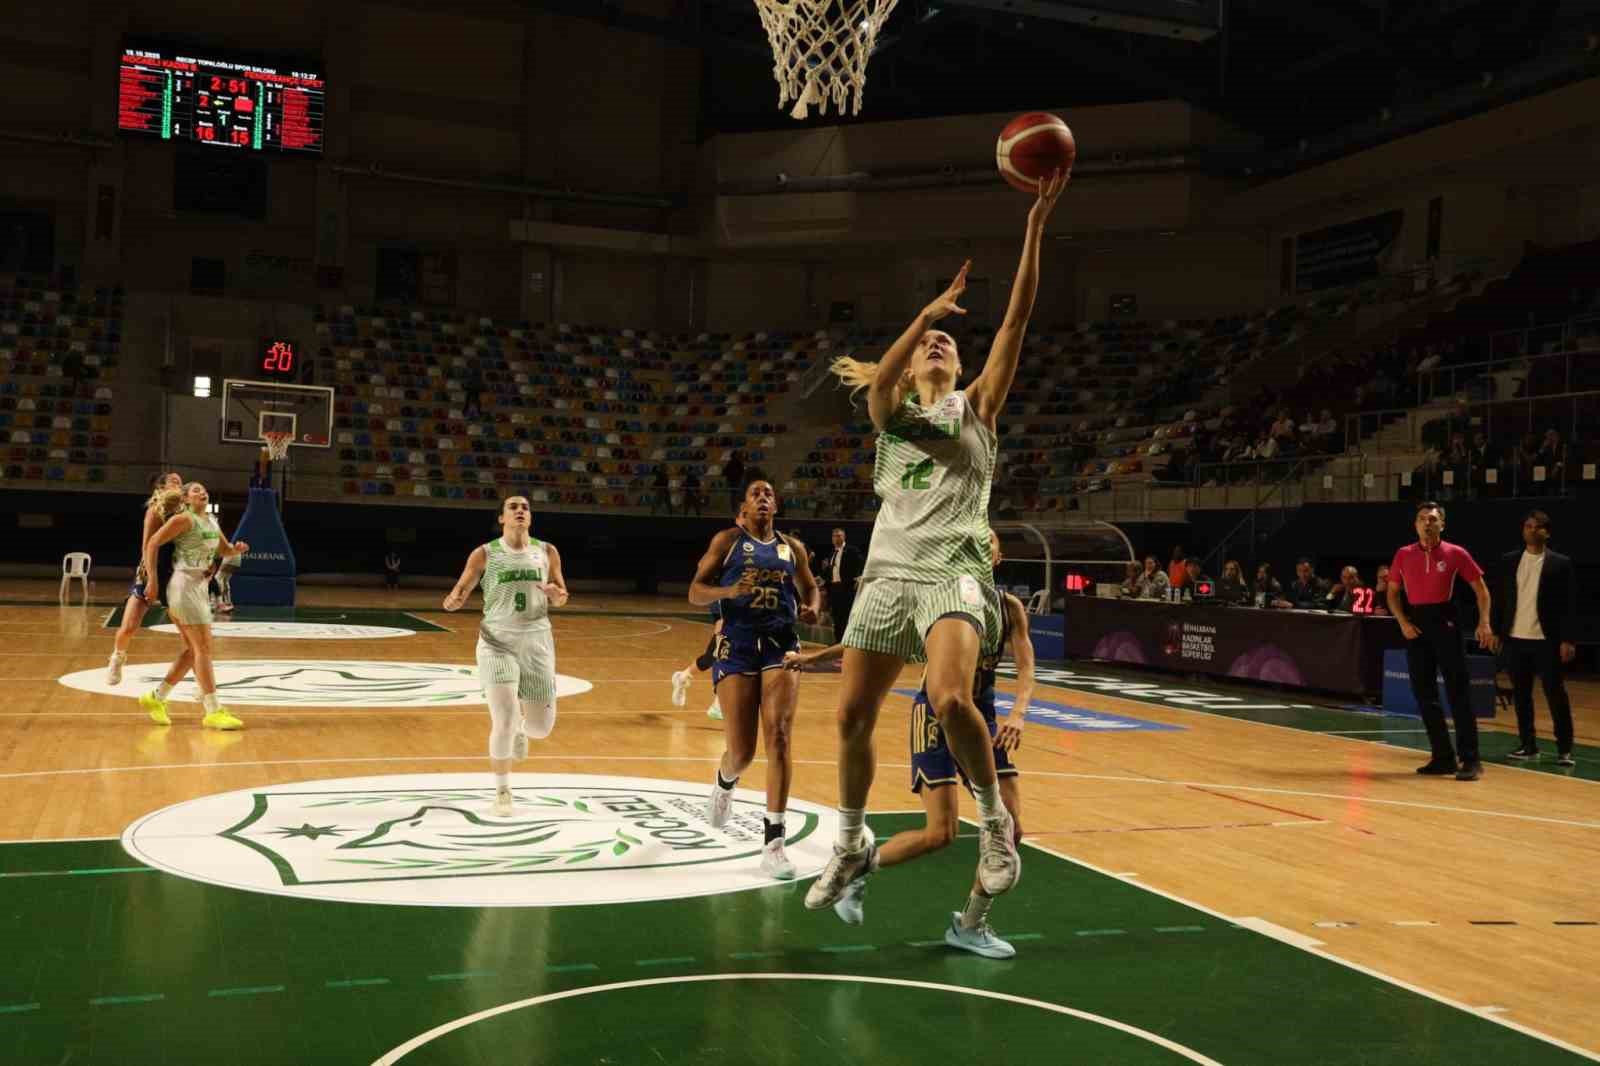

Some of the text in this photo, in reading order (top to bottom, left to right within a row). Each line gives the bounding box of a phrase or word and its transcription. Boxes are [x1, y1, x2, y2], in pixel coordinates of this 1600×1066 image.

[901, 458, 933, 490] 12
[514, 592, 527, 612] 9
[750, 585, 779, 610] 25
[1352, 587, 1373, 613] 22
